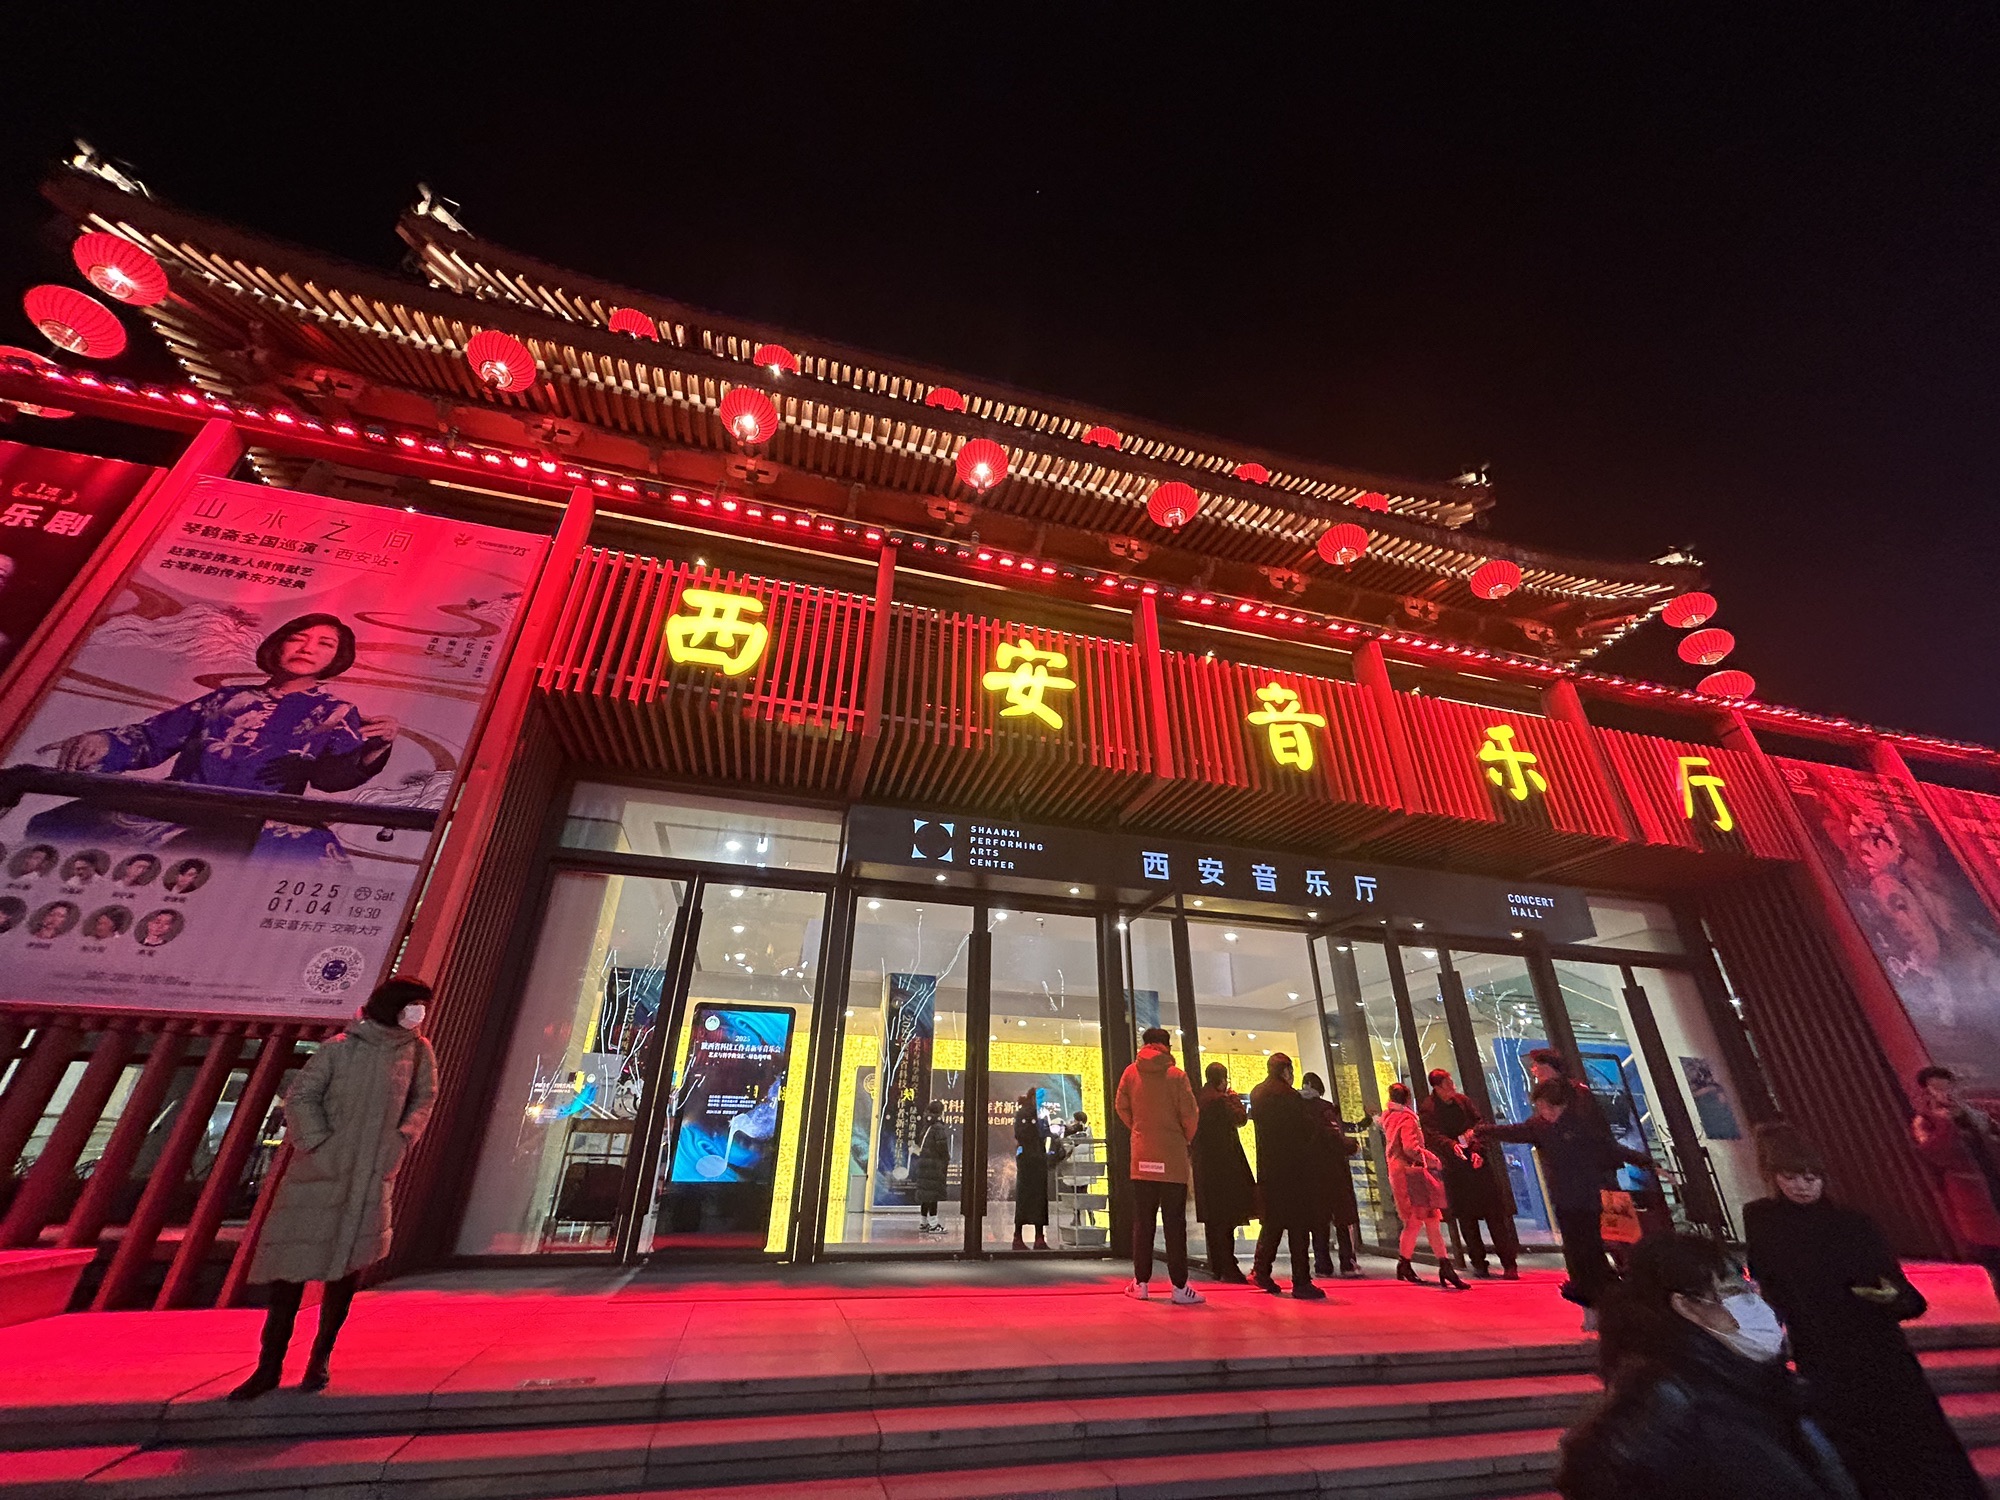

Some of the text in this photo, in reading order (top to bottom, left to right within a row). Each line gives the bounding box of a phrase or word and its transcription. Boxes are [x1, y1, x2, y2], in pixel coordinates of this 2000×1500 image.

[665, 588, 1734, 832] 西安音乐厅
[970, 825, 1020, 838] SHAANXI
[970, 837, 1044, 851] PERFORMING
[970, 847, 1000, 857] ARTS
[969, 858, 1015, 870] CENTER
[1141, 850, 1378, 902] 西安音乐厅
[274, 880, 341, 899] 2025
[267, 897, 382, 919] 01.04 19:30
[1507, 893, 1554, 908] CONCERT
[1510, 906, 1543, 919] HALL
[260, 918, 326, 933] 西安音乐厅
